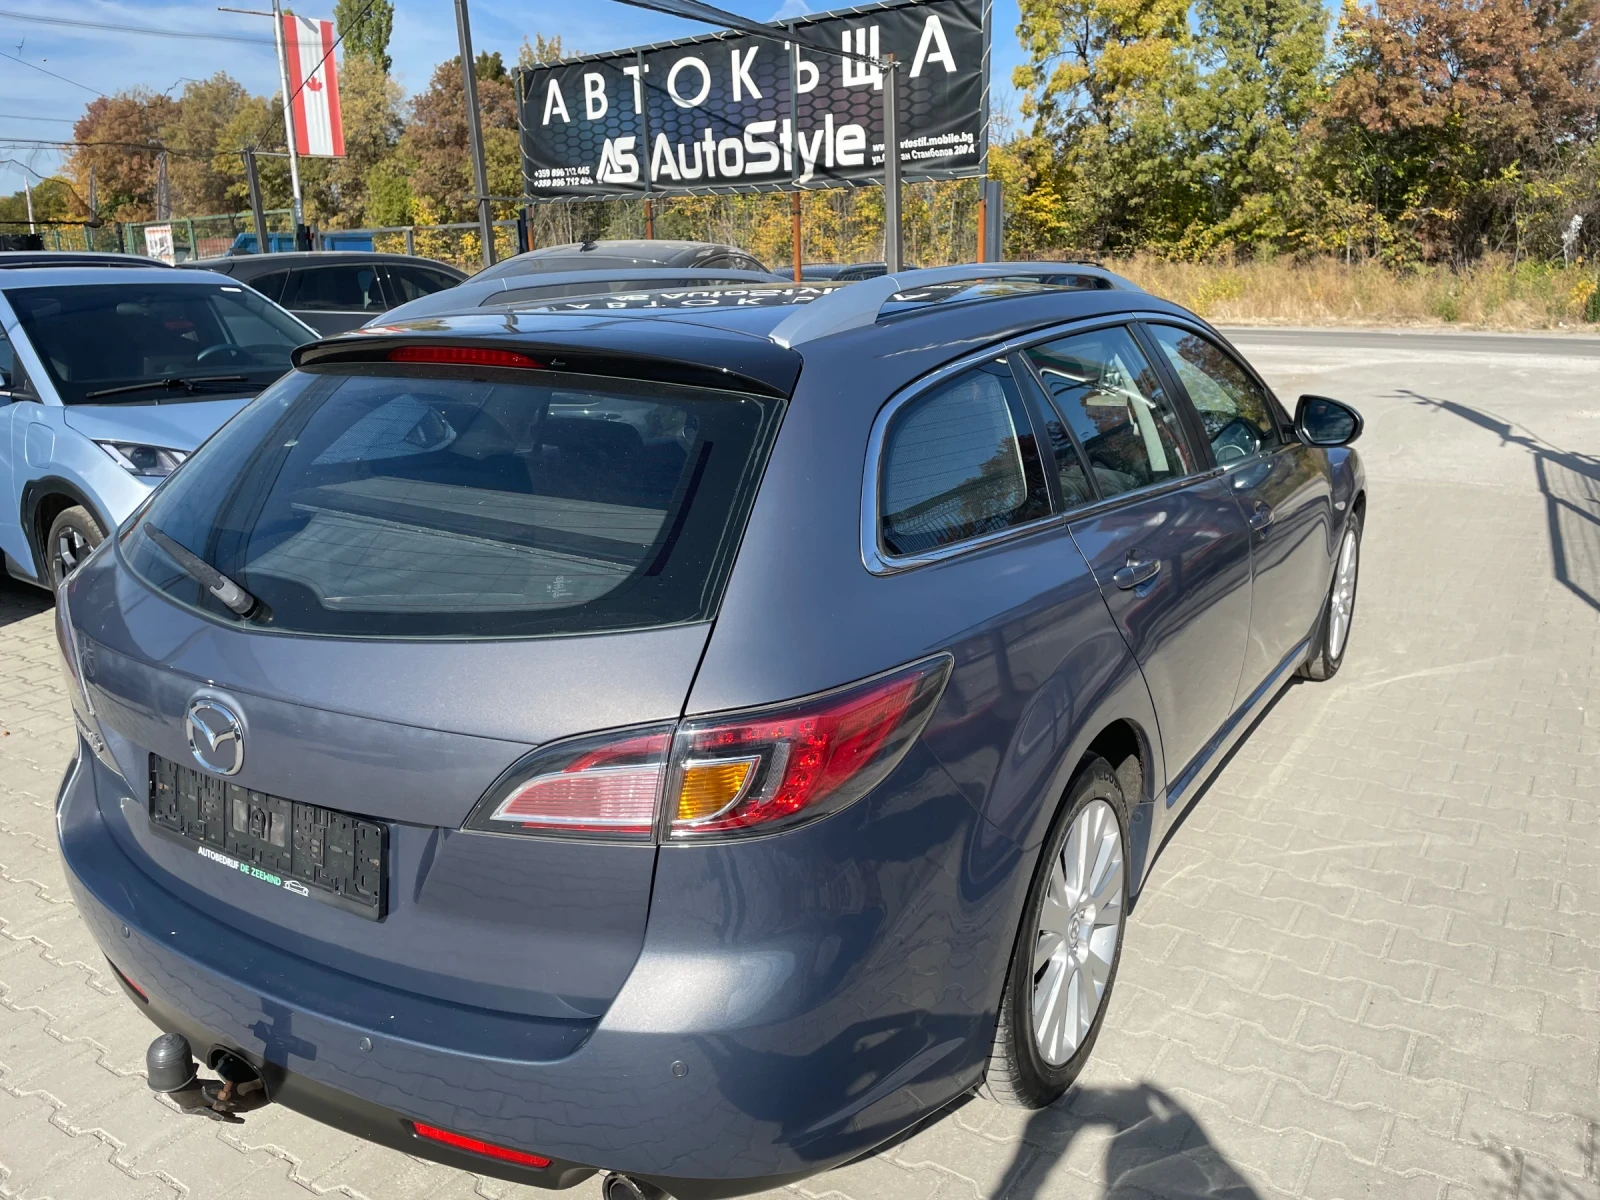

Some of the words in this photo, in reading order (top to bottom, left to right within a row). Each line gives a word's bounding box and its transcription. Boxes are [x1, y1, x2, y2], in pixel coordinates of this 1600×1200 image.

[651, 113, 866, 184] AutoStyle
[533, 179, 551, 187] +359
[566, 177, 579, 186] 712
[534, 169, 551, 178] +359
[197, 845, 240, 870] AUTOBEDRIJF
[240, 862, 250, 875] DE
[250, 867, 282, 887] ZEEWIND
